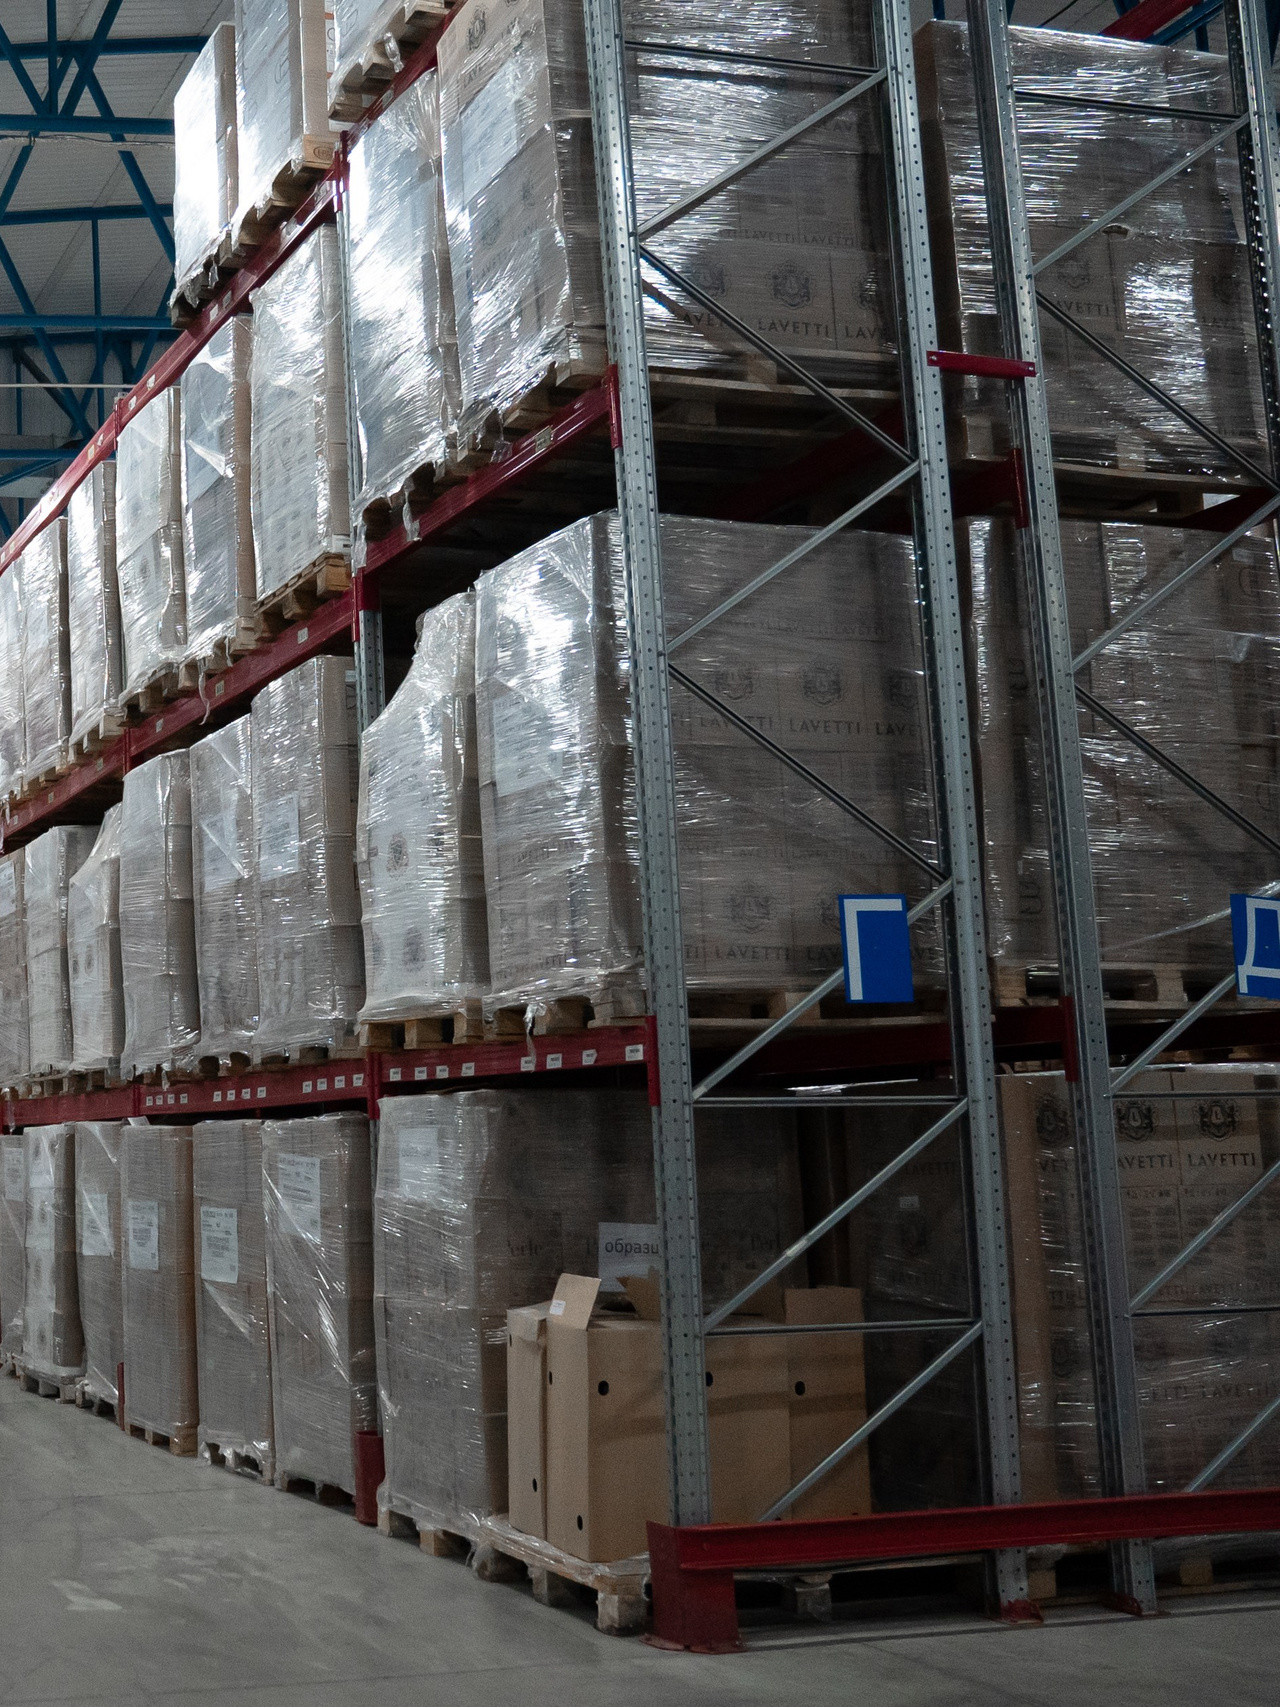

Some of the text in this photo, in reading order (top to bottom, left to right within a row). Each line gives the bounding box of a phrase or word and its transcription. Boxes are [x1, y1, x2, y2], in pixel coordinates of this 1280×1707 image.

[1056, 299, 1110, 318] AVETTI
[757, 316, 830, 339] LAVETTI
[789, 720, 861, 736] LAVETTI
[876, 722, 916, 737] LAVE
[715, 944, 790, 961] LAVETTI
[843, 898, 903, 1001] Г
[1118, 1152, 1256, 1169] AVETTI LAVETTI
